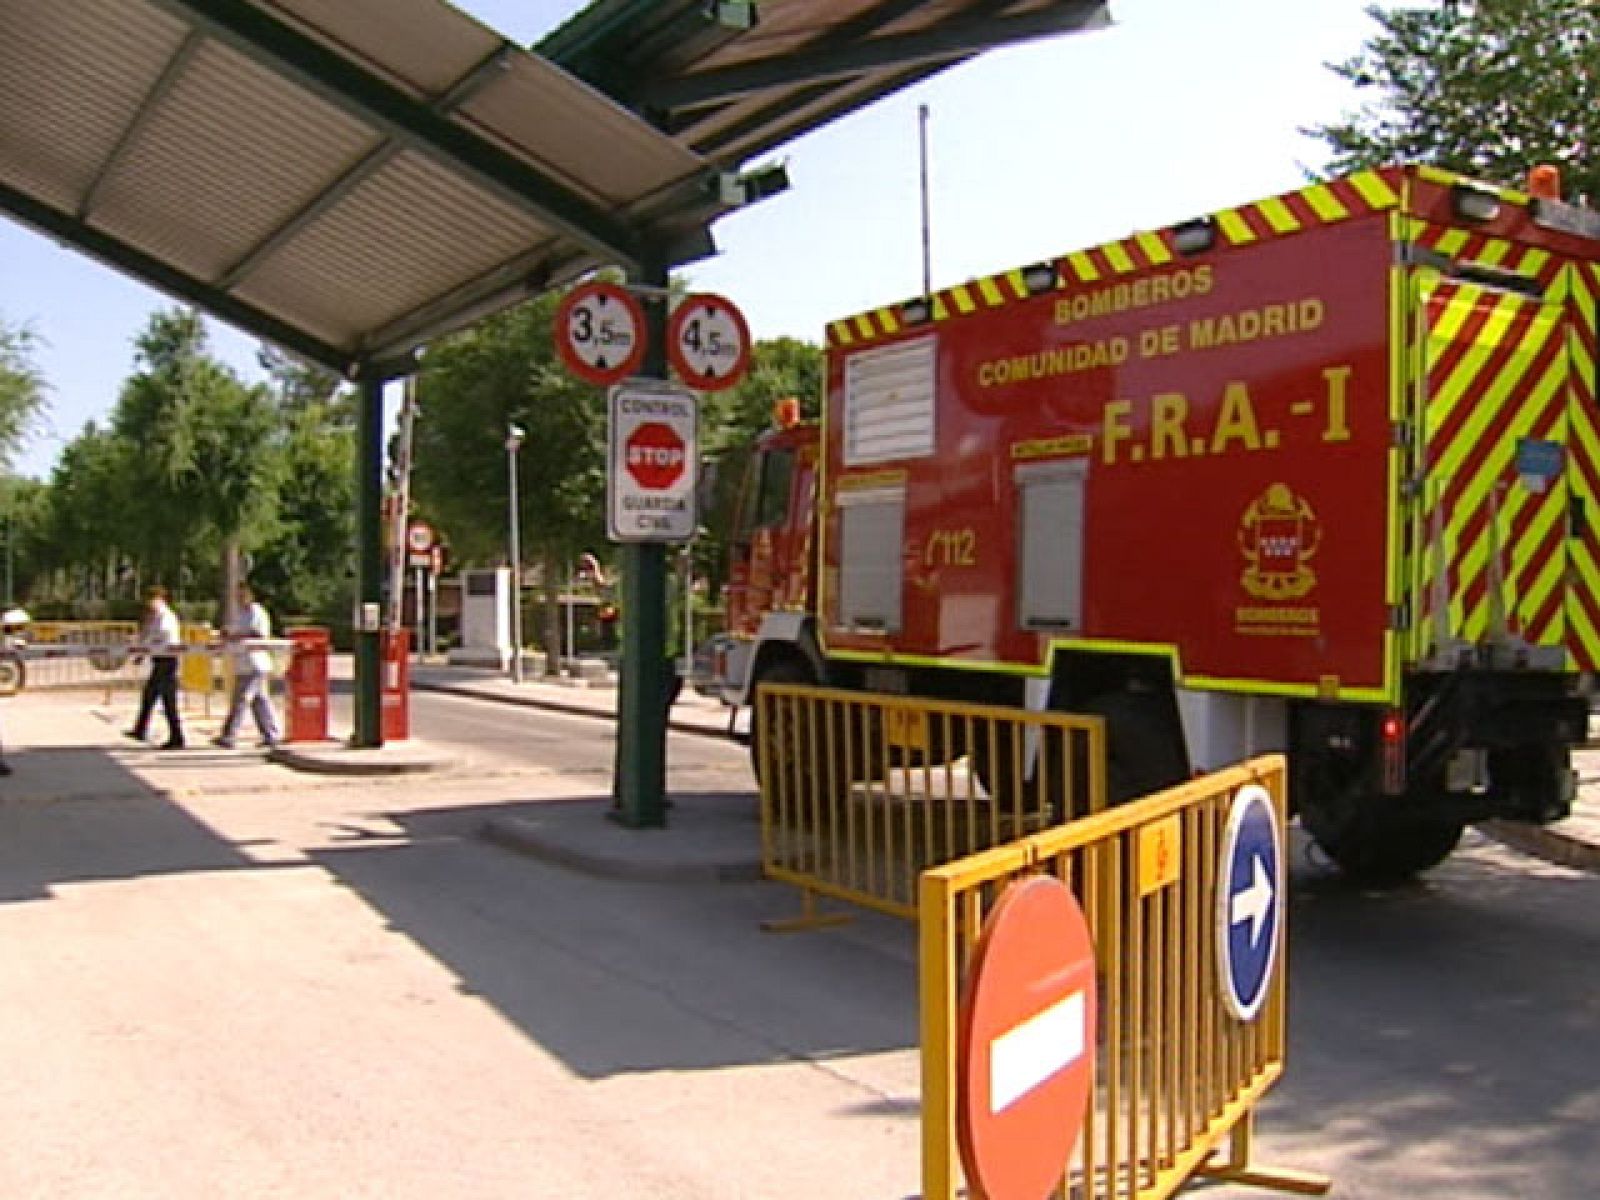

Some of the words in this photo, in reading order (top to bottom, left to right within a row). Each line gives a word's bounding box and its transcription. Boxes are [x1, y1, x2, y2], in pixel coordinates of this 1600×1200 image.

[1054, 264, 1214, 326] BOMBEROS
[977, 336, 1129, 388] COMUNIDAD
[1139, 325, 1181, 359] DE
[1188, 297, 1325, 351] MADRID
[621, 398, 690, 418] CONTROL
[1102, 380, 1282, 466] F.R.A.
[627, 445, 684, 466] STOP
[622, 495, 688, 512] GUARDIA
